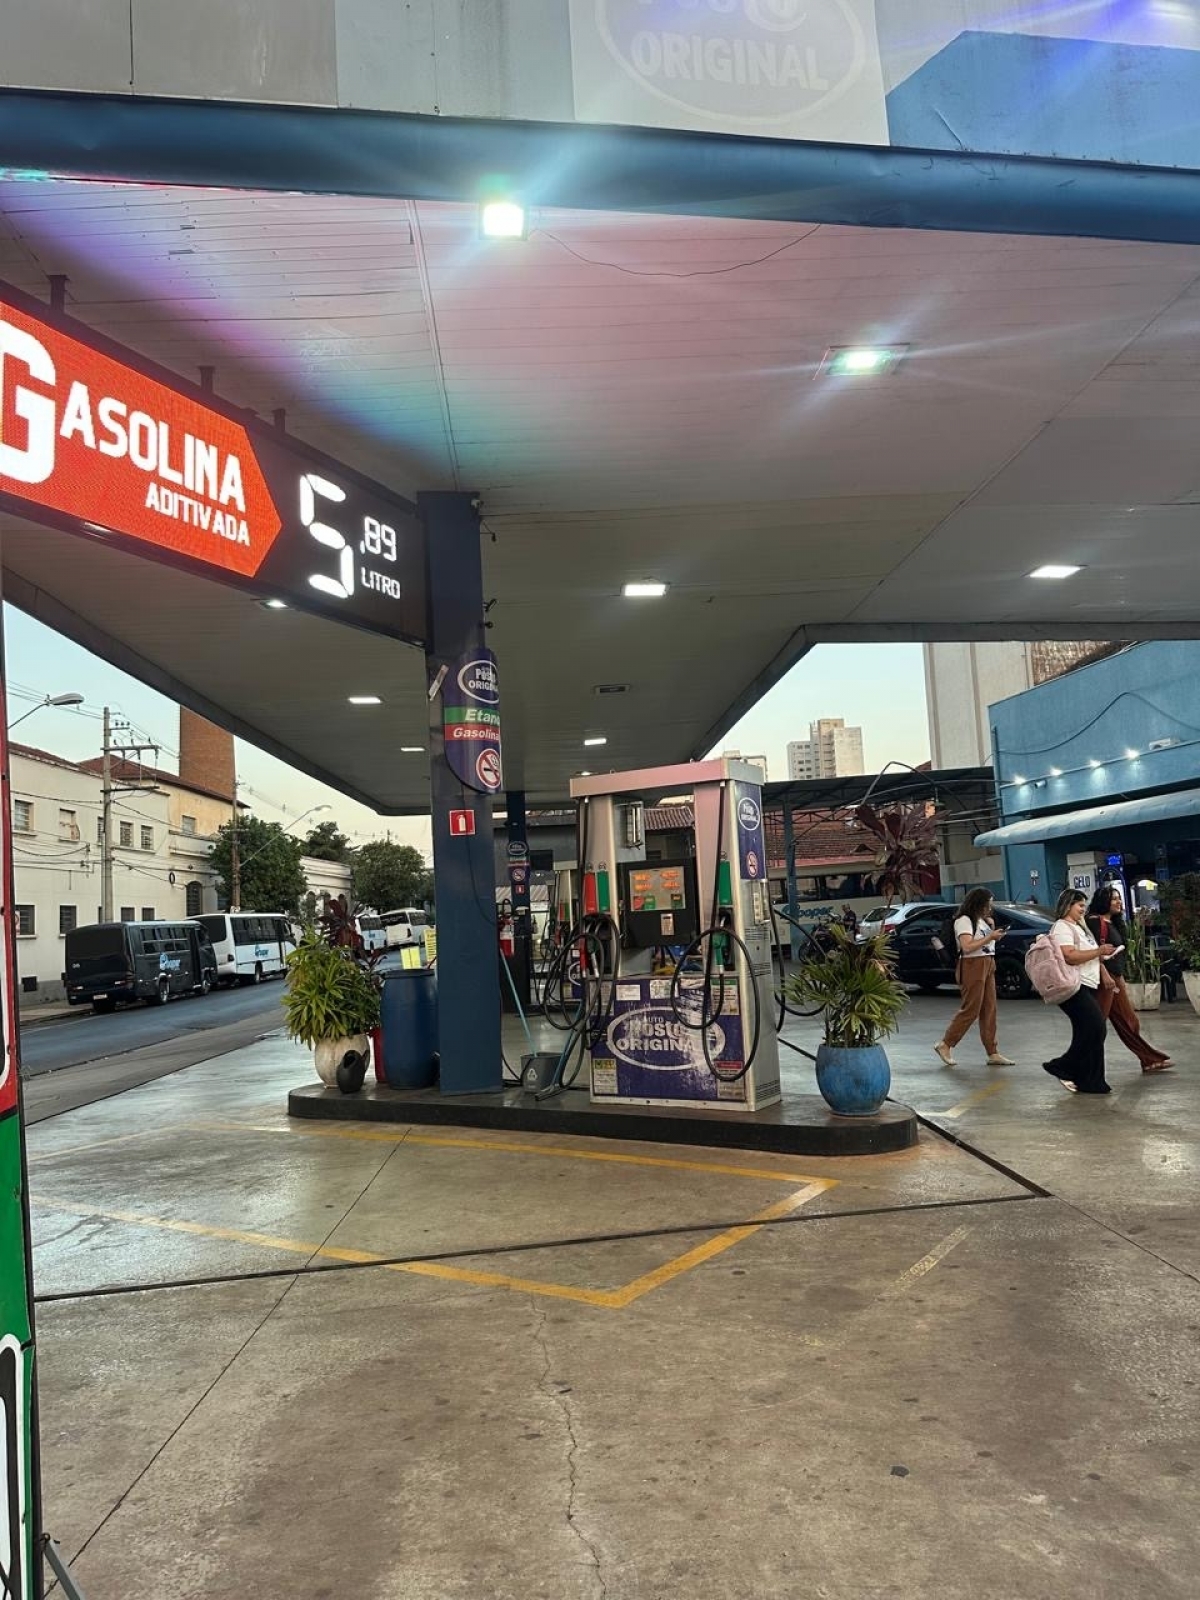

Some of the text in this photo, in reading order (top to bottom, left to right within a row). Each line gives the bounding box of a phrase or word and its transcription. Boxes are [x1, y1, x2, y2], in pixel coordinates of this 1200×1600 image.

[630, 31, 829, 91] ORIGINAL
[0, 319, 246, 513] GASOLINA
[145, 483, 251, 547] ADITIVADA
[361, 567, 401, 600] LITRO
[615, 1038, 703, 1051] ORIGINA
